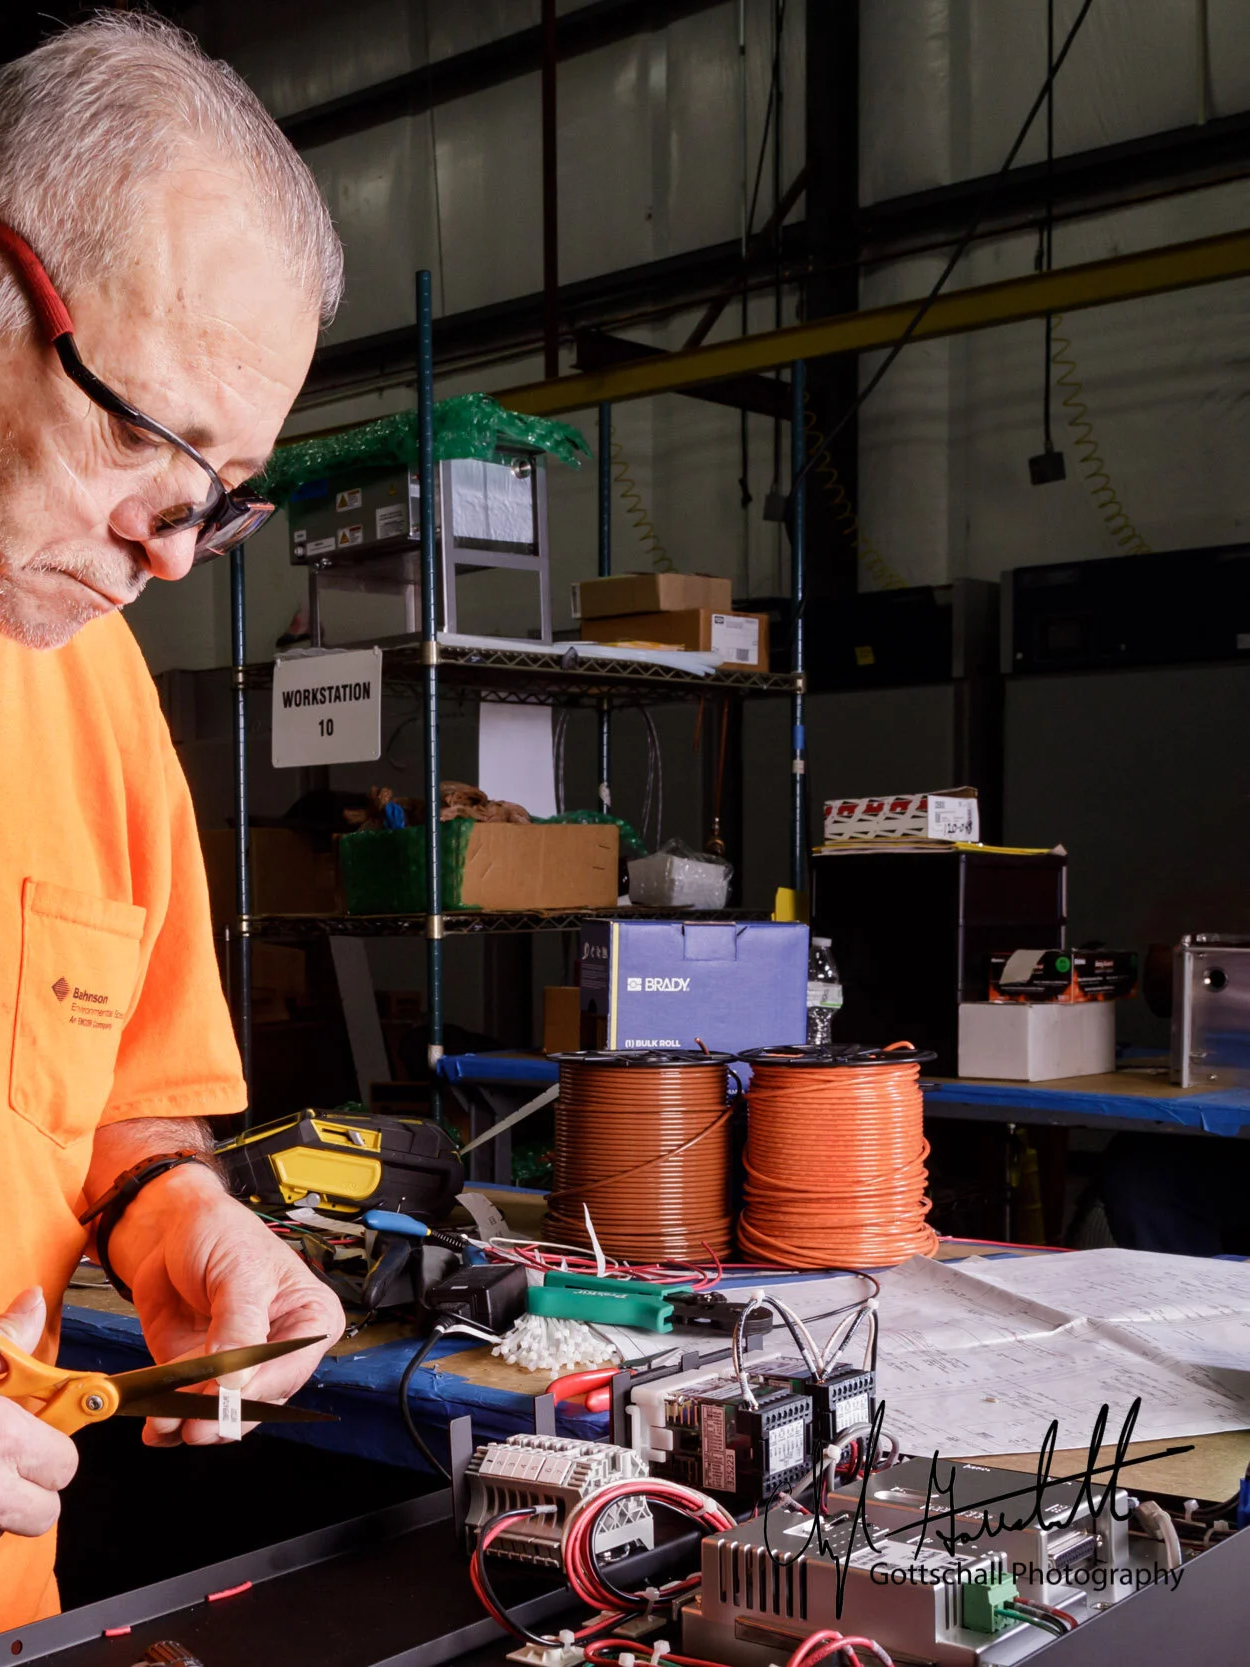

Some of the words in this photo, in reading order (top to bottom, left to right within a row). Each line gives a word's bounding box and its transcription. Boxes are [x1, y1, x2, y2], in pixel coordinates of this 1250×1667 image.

[282, 681, 371, 709] WORKSTATION
[318, 718, 334, 737] 10
[645, 977, 690, 992] BRADY
[624, 1039, 635, 1049] (1)
[636, 1040, 658, 1048] BULK
[659, 1040, 681, 1048] ROLL
[726, 1454, 735, 1487] 325223
